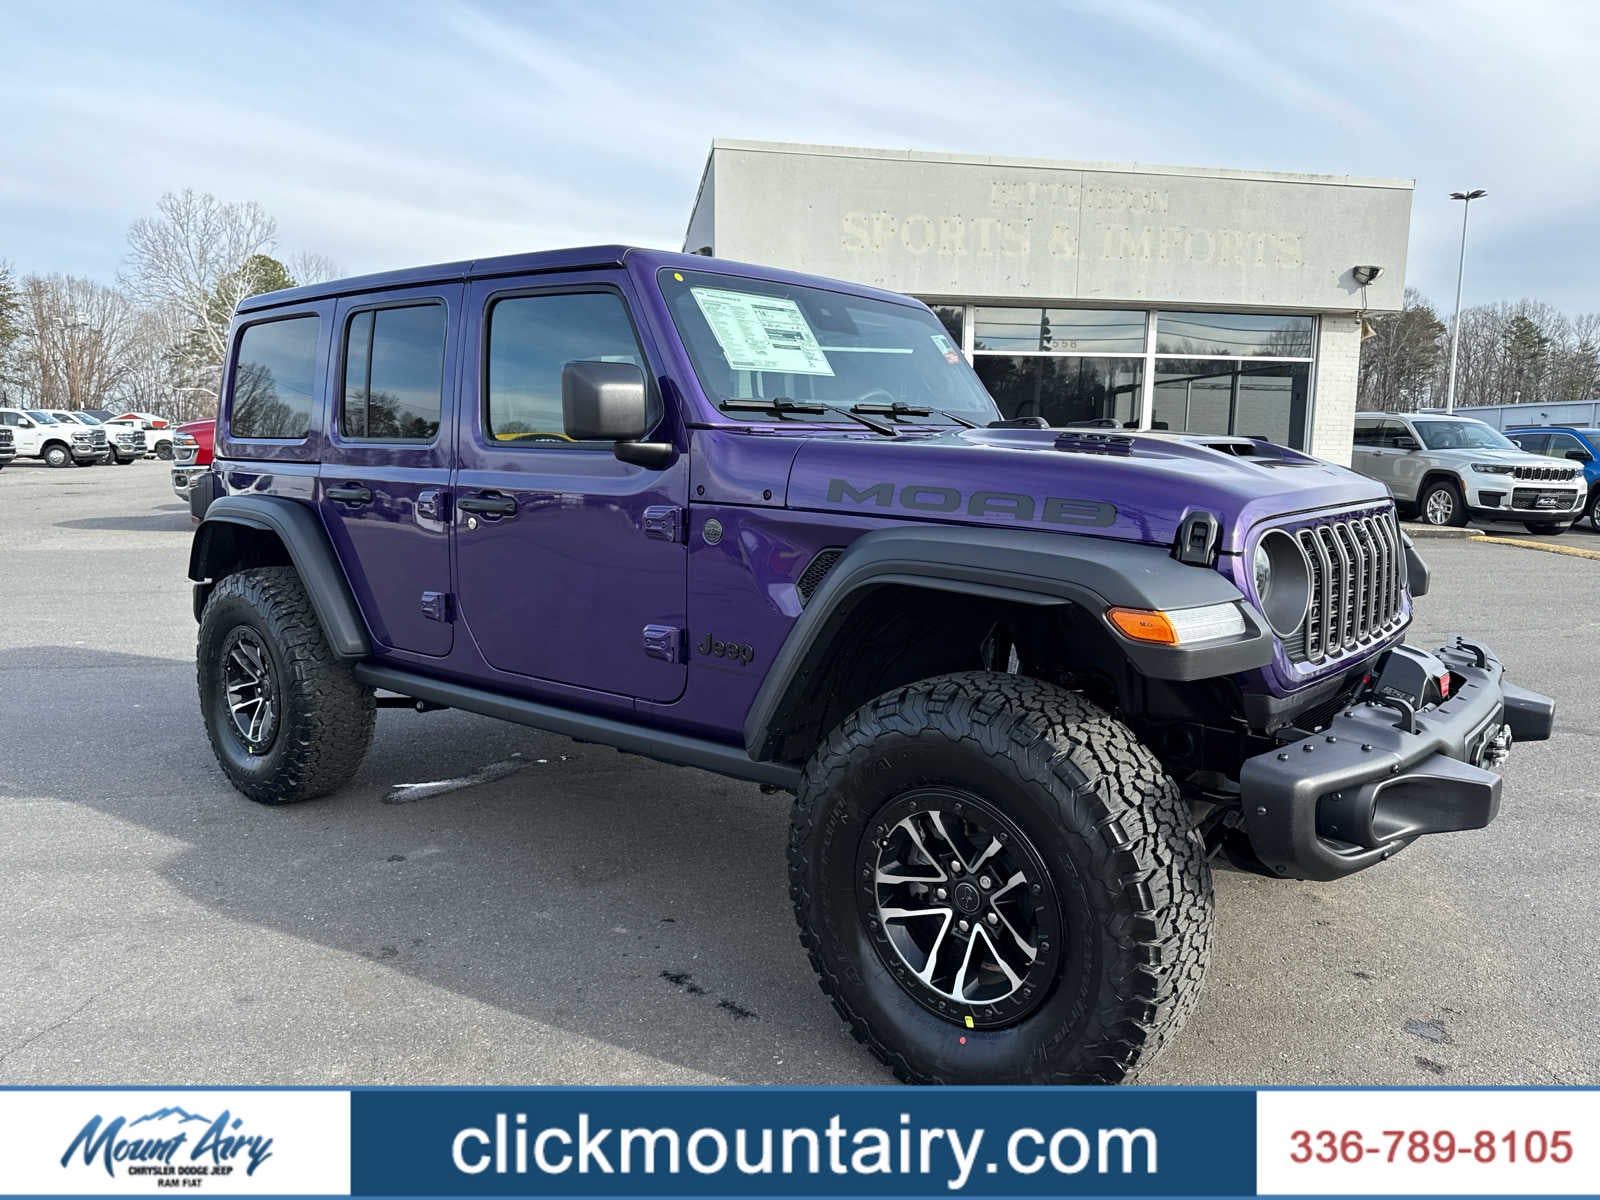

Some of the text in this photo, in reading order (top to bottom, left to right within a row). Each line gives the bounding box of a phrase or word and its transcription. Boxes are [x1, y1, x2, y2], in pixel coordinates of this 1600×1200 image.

[841, 210, 1304, 268] SPORTS & IMPORTS
[826, 478, 1119, 529] MOAB
[697, 633, 755, 666] Jeep
